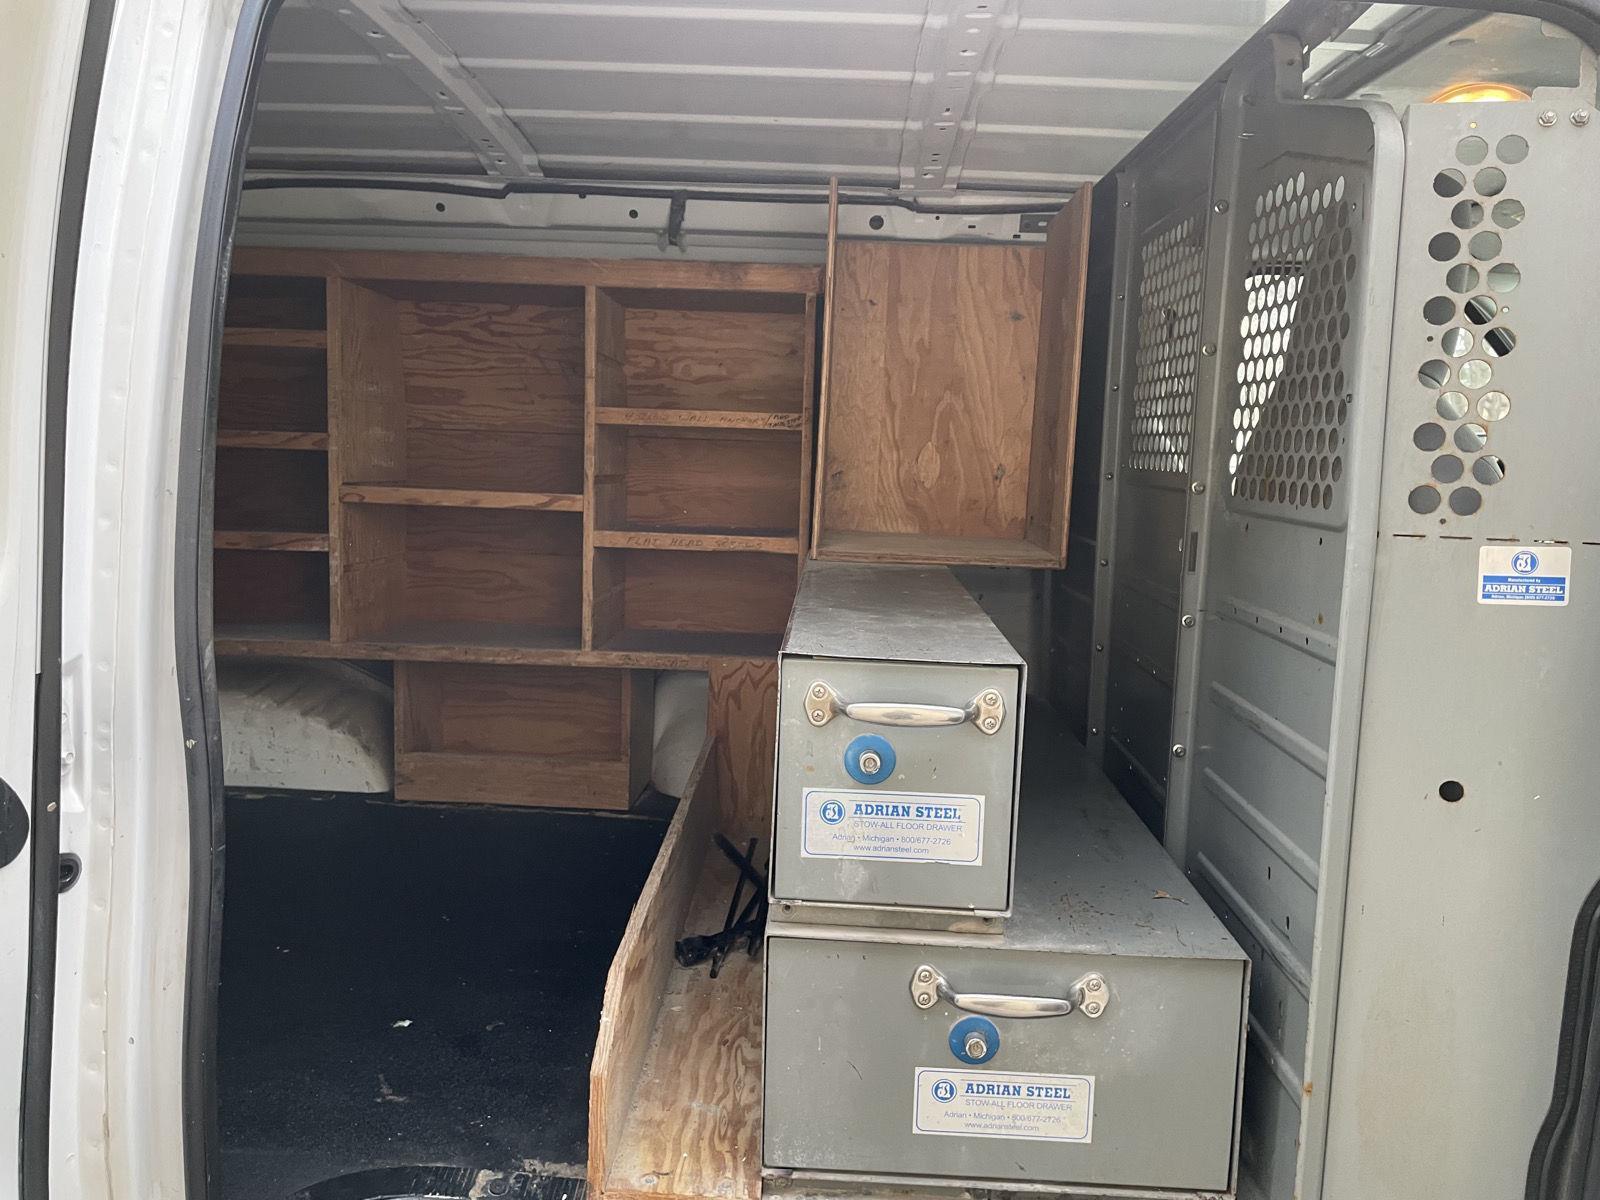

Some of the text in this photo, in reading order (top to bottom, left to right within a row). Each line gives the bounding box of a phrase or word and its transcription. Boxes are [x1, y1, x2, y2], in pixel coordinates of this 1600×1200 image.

[626, 536, 661, 547] FLAT
[670, 537, 704, 548] HEAD
[1485, 584, 1563, 594] ADRIAN STEEL
[853, 803, 911, 818] ADRIAN
[915, 806, 961, 820] STEEL
[854, 820, 962, 832] STOW-ALL FLOOR DRAWER
[862, 834, 895, 844] Michigan
[964, 1082, 1021, 1097] ADRIAN
[1026, 1086, 1071, 1099] STEEL
[965, 1099, 1073, 1111] STOW-ALL FLOOR DRAWER
[944, 1110, 967, 1119] Adrian
[973, 1112, 1006, 1122] Michigan
